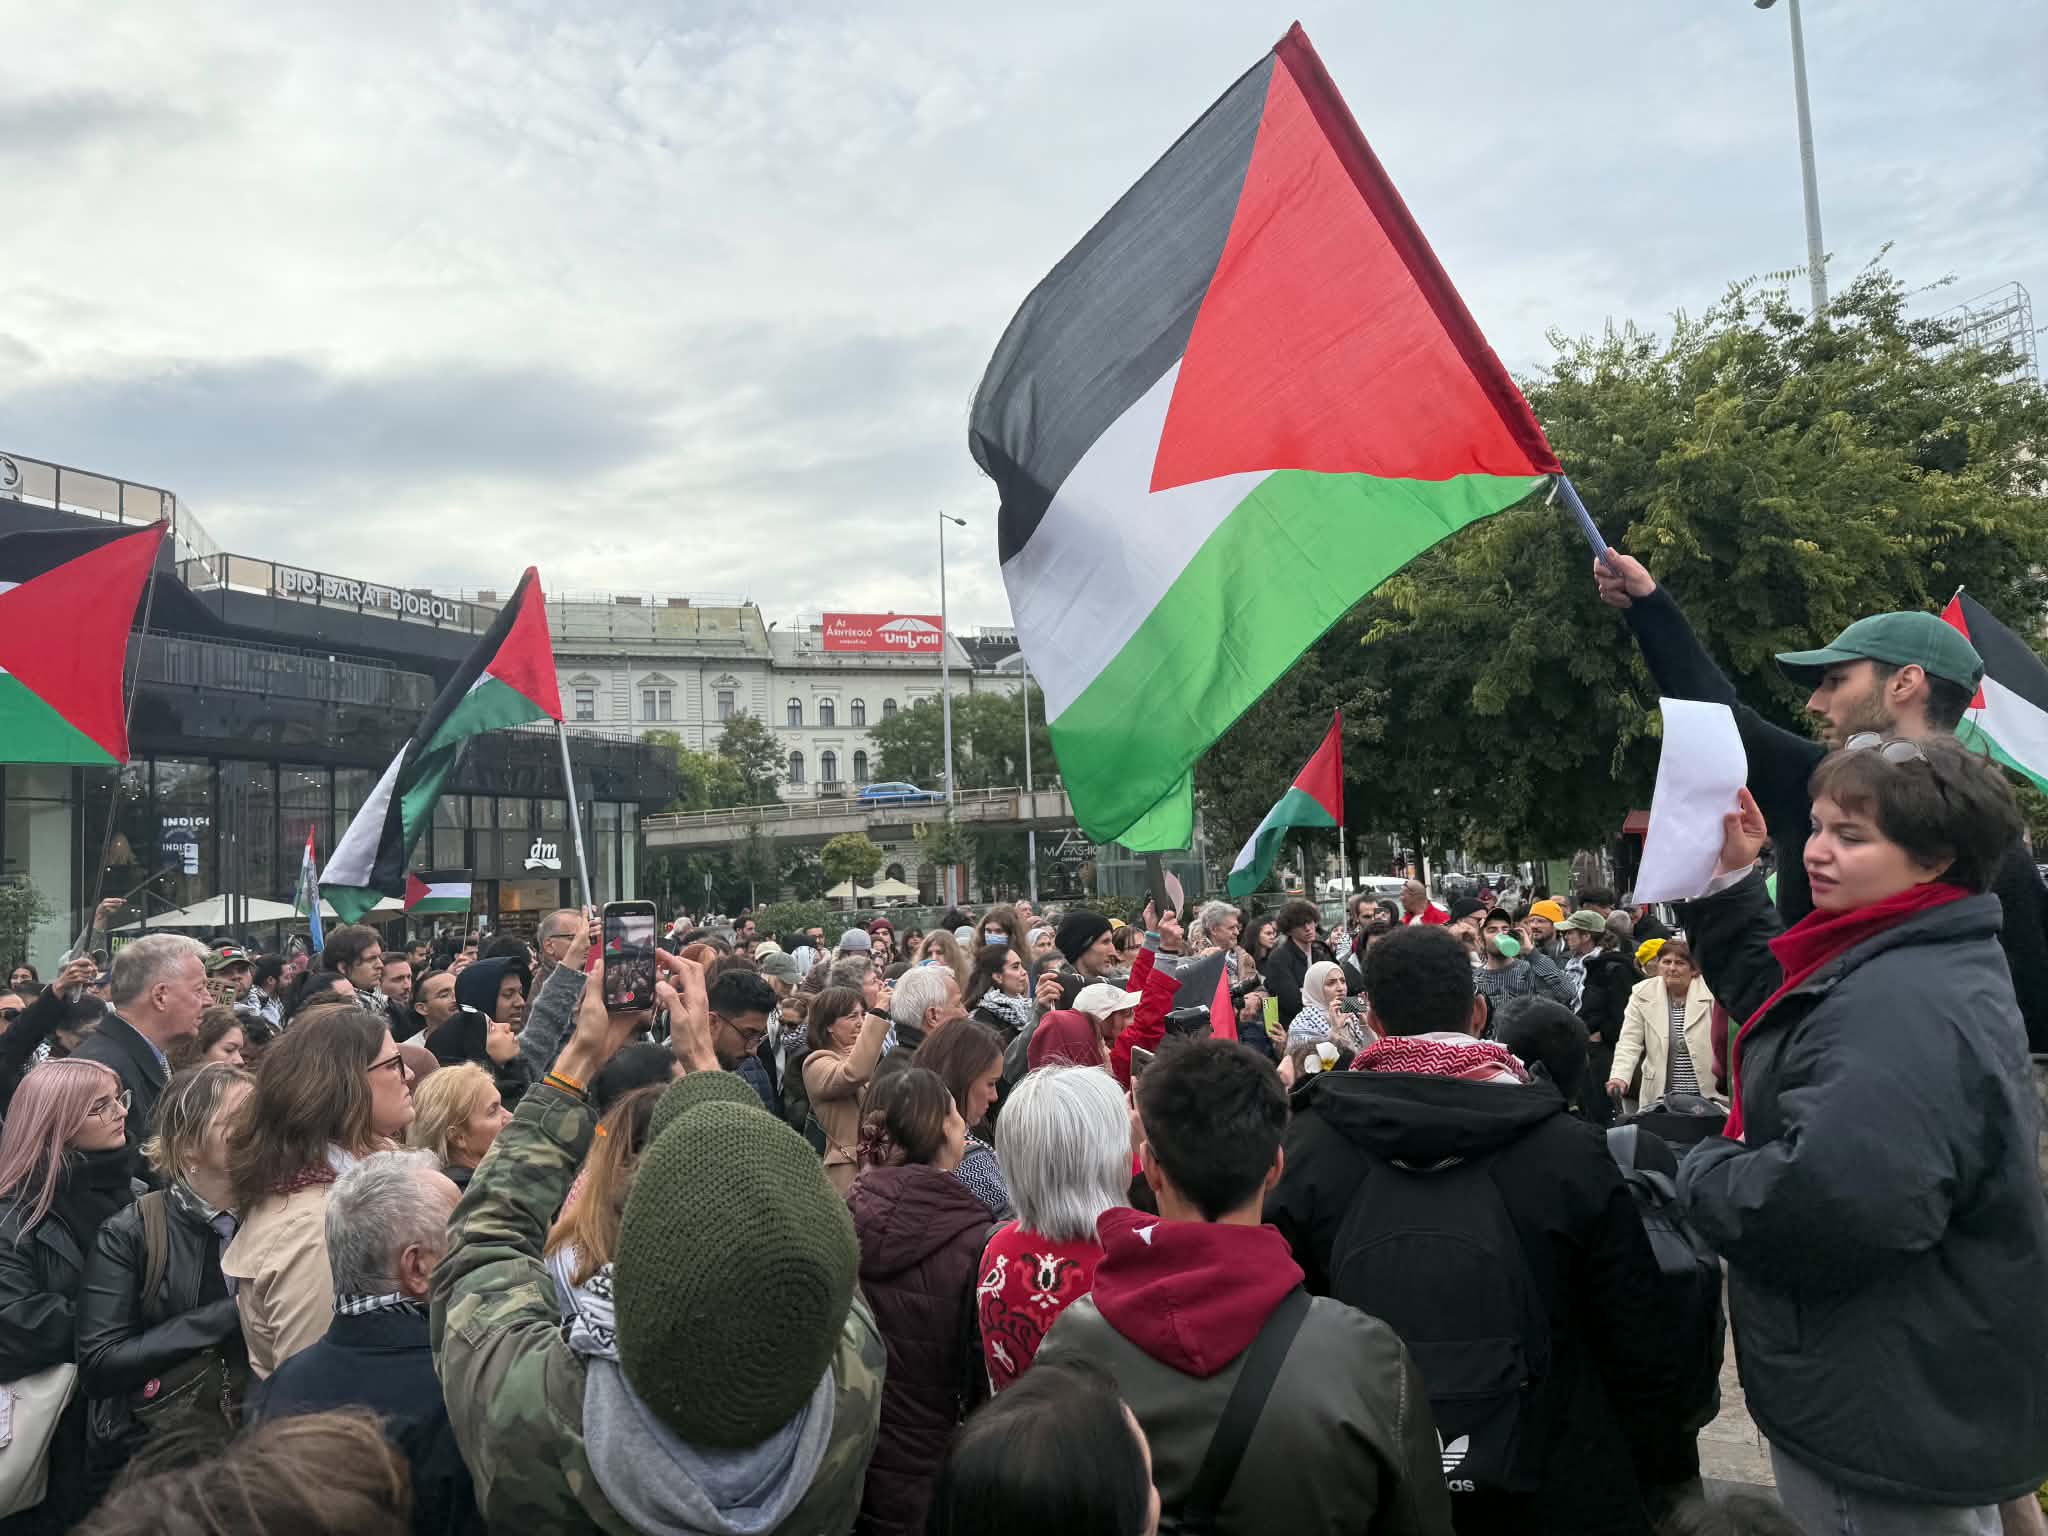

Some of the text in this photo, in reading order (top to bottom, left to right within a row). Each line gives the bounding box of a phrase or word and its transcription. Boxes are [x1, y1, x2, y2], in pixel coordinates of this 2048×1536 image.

[391, 590, 462, 622] BIOBOLT
[884, 631, 938, 649] Umbroll
[530, 837, 558, 859] dm
